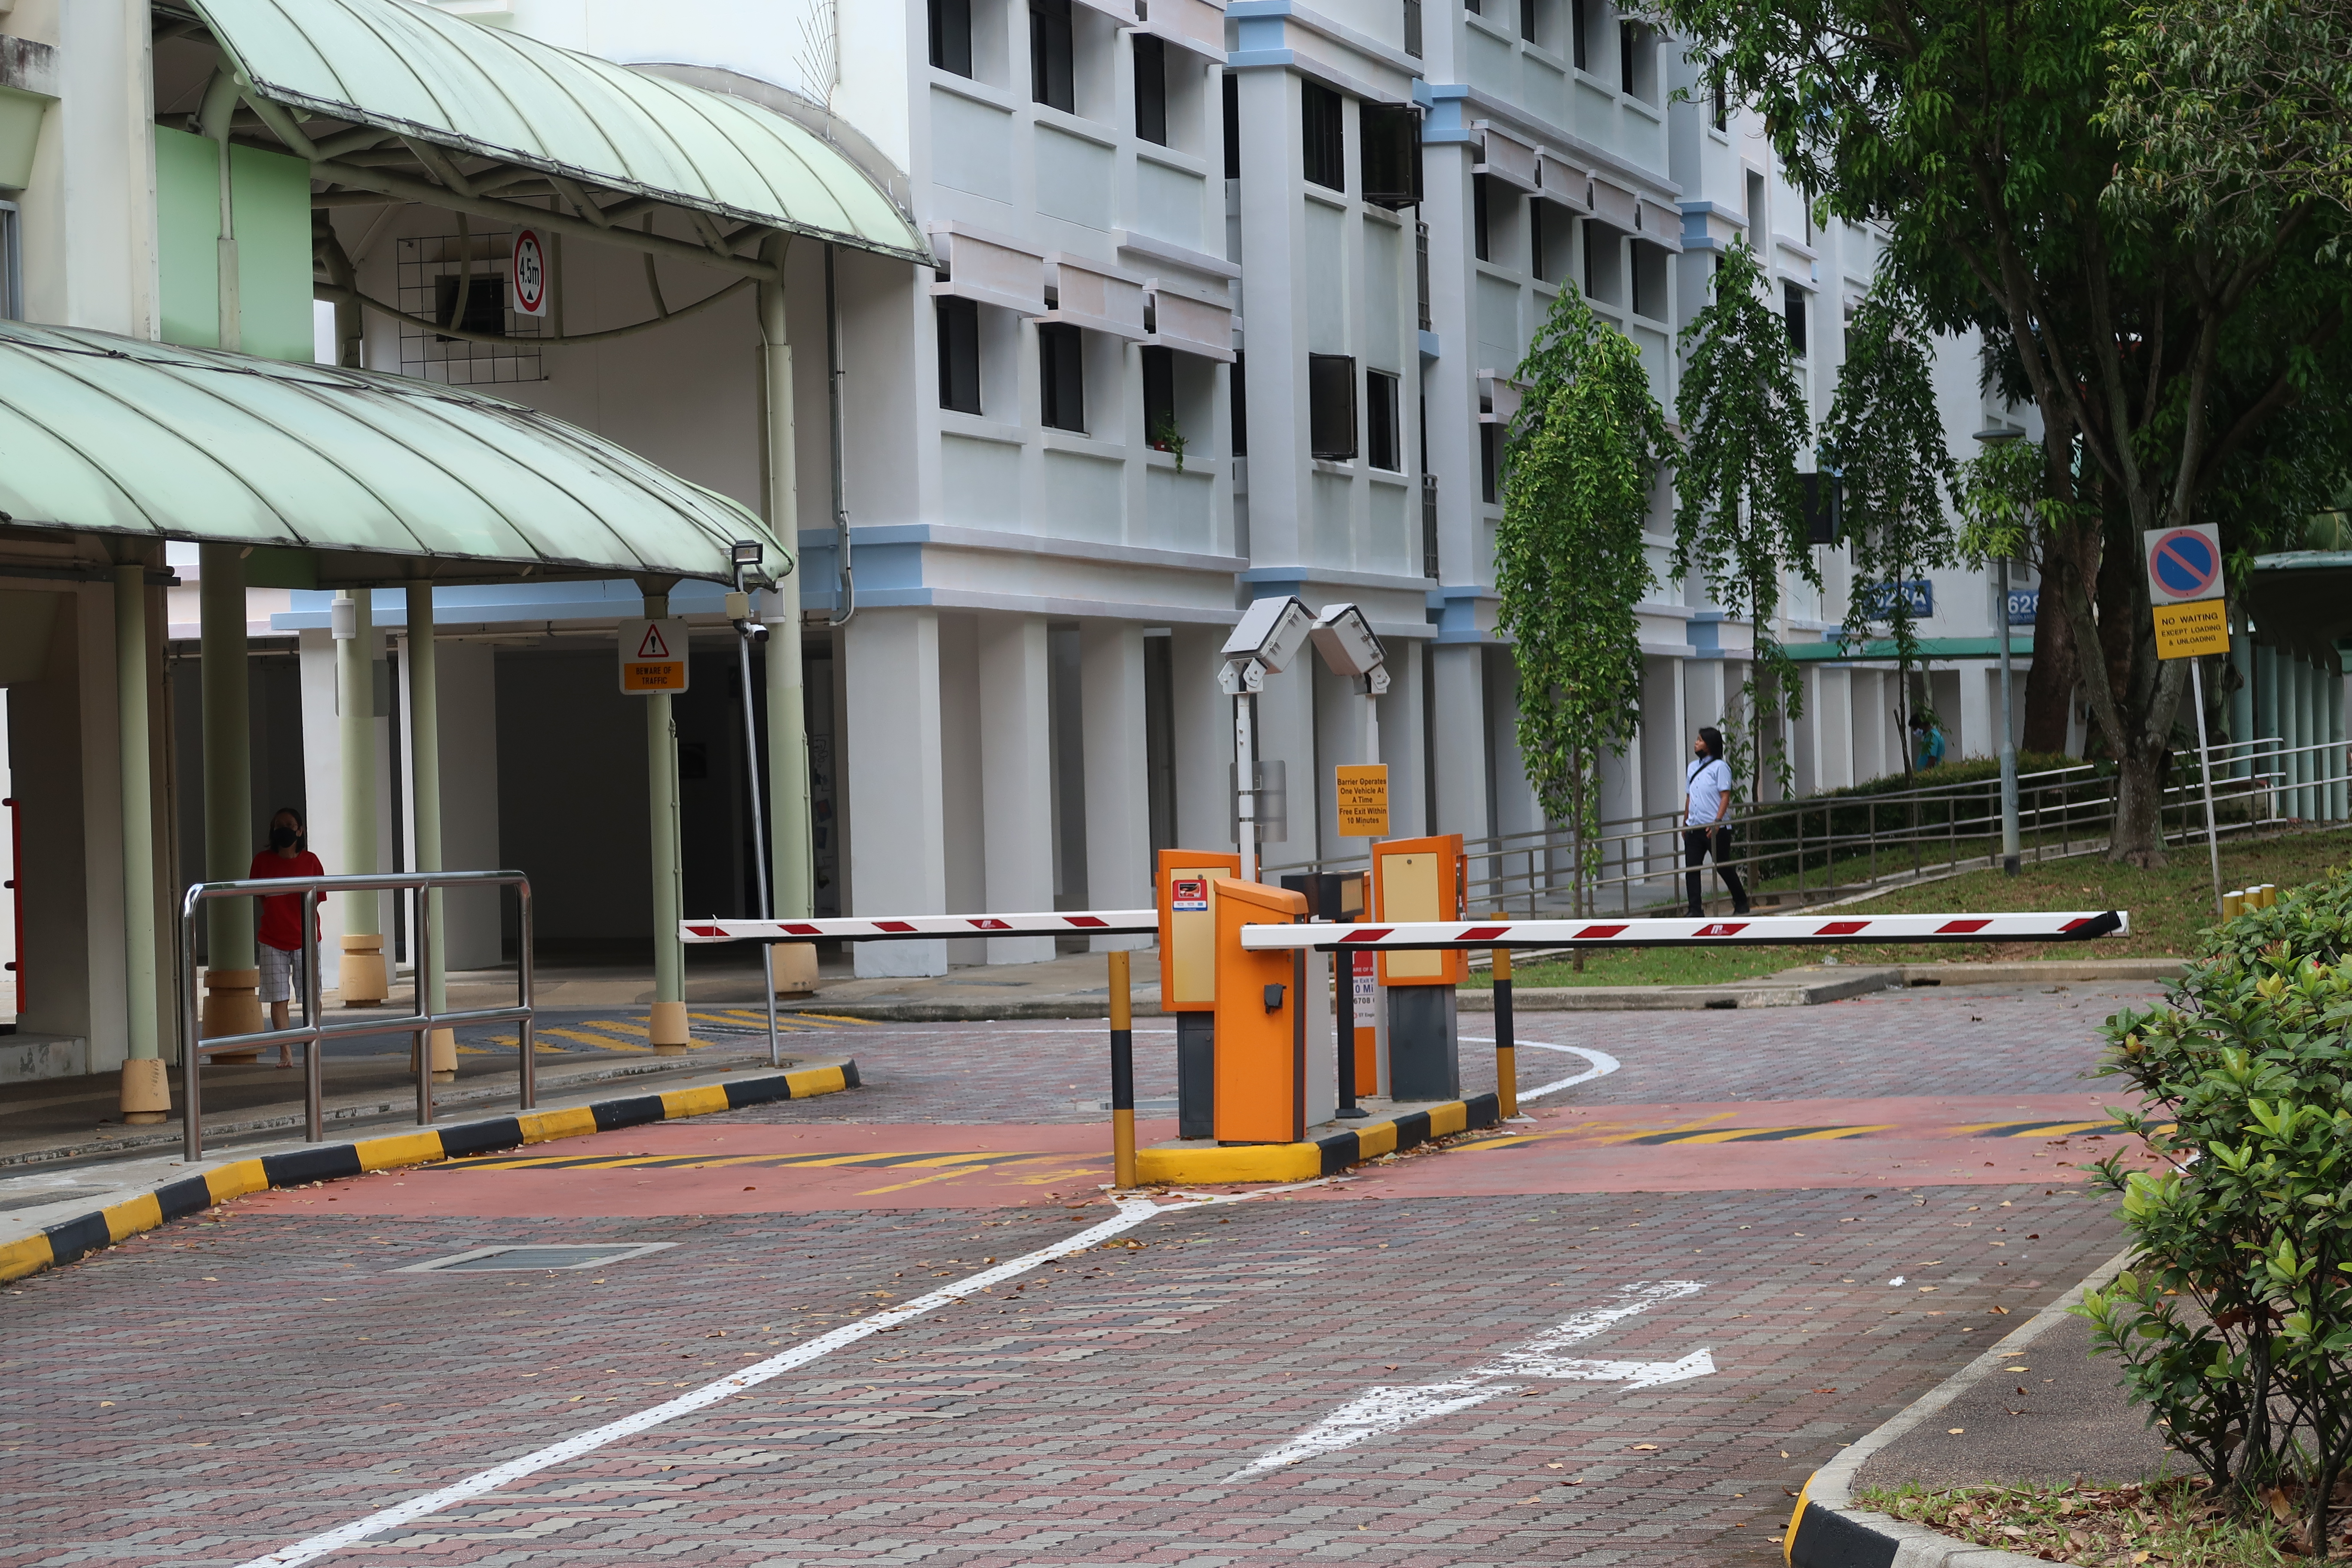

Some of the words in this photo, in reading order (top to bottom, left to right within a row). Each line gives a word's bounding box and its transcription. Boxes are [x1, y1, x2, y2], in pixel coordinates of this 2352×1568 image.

[519, 257, 539, 287] 4.5m
[2162, 617, 2175, 626] NO
[2180, 612, 2219, 624] WAITING
[2161, 628, 2188, 637] EXCEPT
[2191, 624, 2221, 634] LOADING
[2177, 635, 2217, 645] UNLOADING
[636, 667, 661, 675] BEWARE
[642, 677, 668, 685] TRAFFIC
[1360, 778, 1387, 786] Operates
